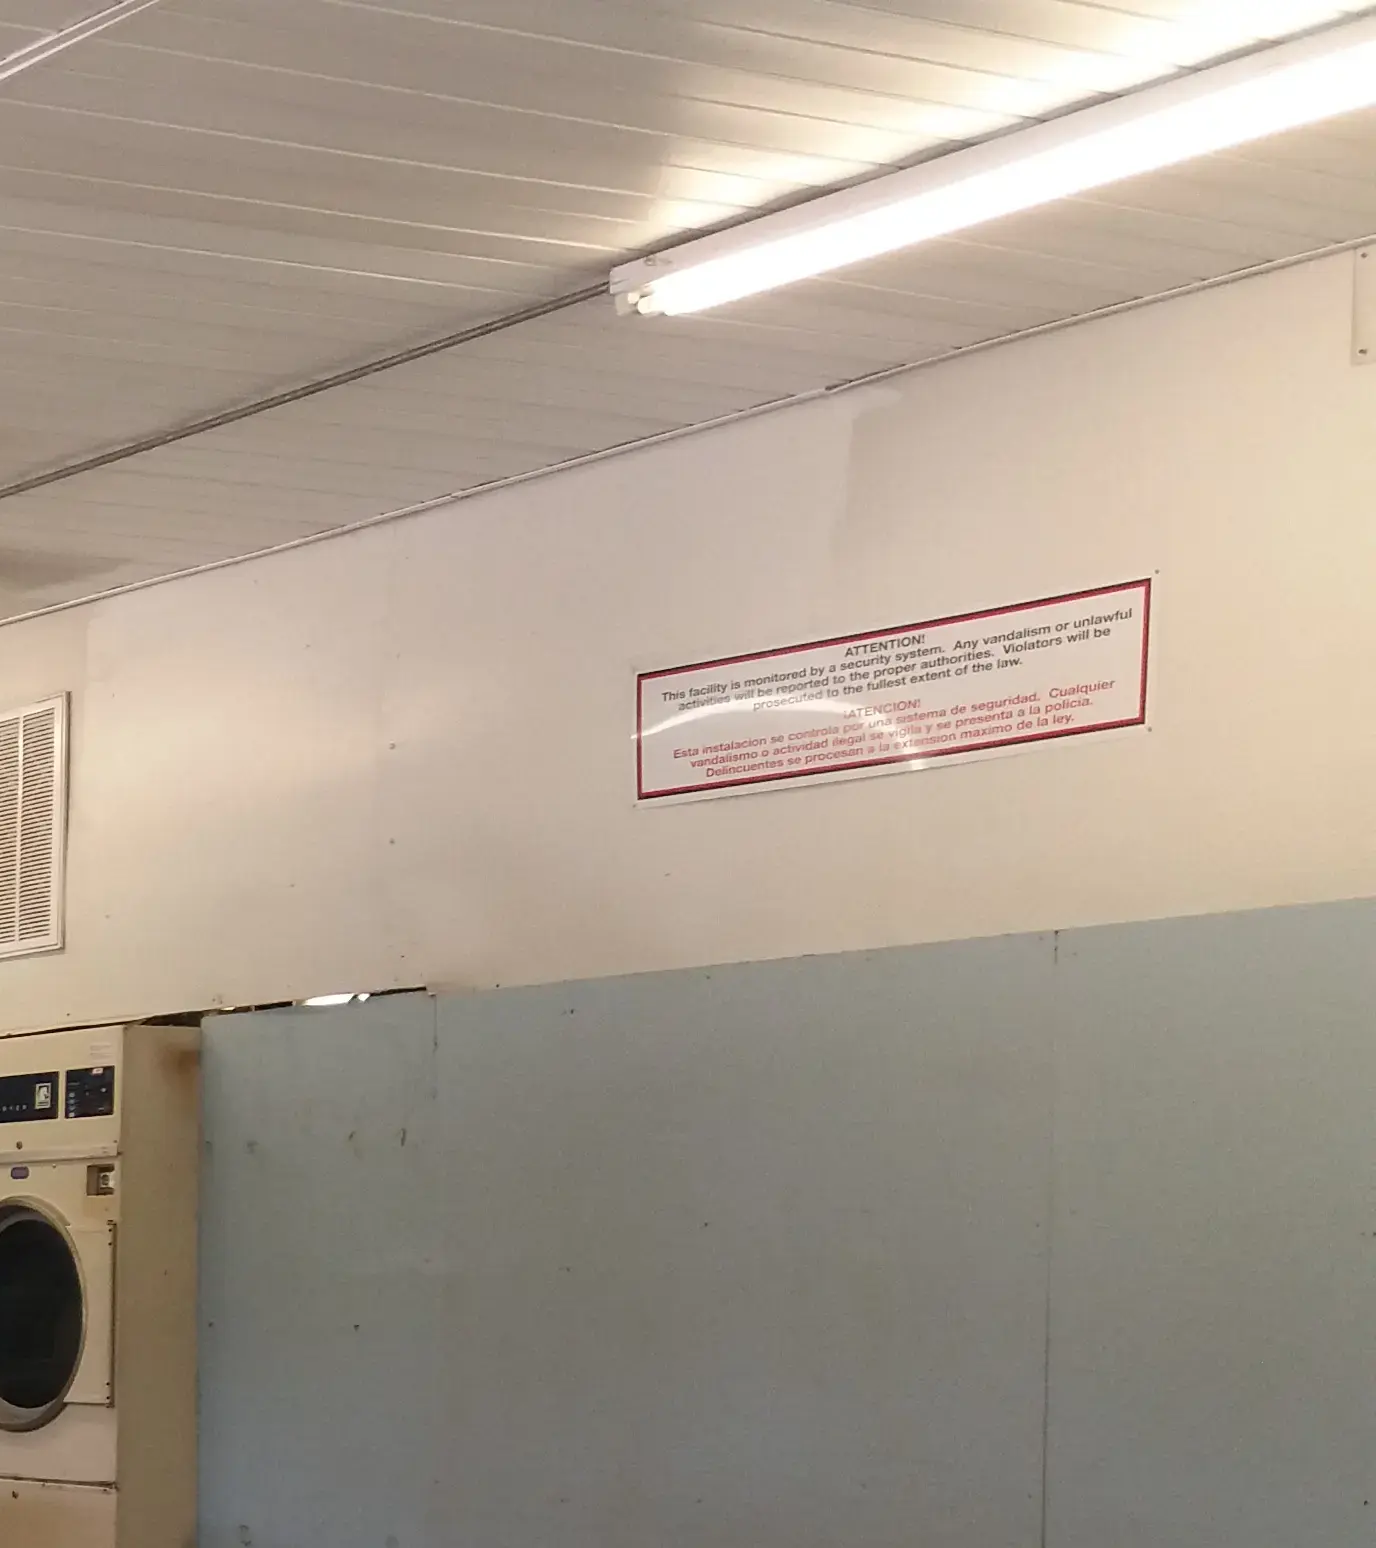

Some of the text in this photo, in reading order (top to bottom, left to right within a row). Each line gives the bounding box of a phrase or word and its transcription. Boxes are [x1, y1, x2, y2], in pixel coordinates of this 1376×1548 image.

[661, 607, 1133, 702] This facility is monitored by a security system. Any vandalism or unlawful
[677, 627, 1111, 711] activities will be reported to the proper authorities. Violators will be
[844, 634, 926, 658] ATTENTION!
[672, 679, 1116, 759] Esta instalacion se controla por una sistema de seguridad. Cualquier
[752, 656, 1024, 712] prosecuted to the fullest extent of the law.
[690, 751, 758, 769] vandalismo
[761, 749, 769, 757] o
[772, 738, 829, 756] actividad
[870, 731, 884, 741] se
[926, 724, 932, 735] y
[936, 720, 952, 731] se
[955, 710, 1013, 731] presenta
[1017, 708, 1025, 717] a
[1029, 703, 1041, 715] la
[1044, 697, 1094, 716] policia.
[705, 713, 1075, 777] Delincuentes se procesan a la extension maximo de la ley.
